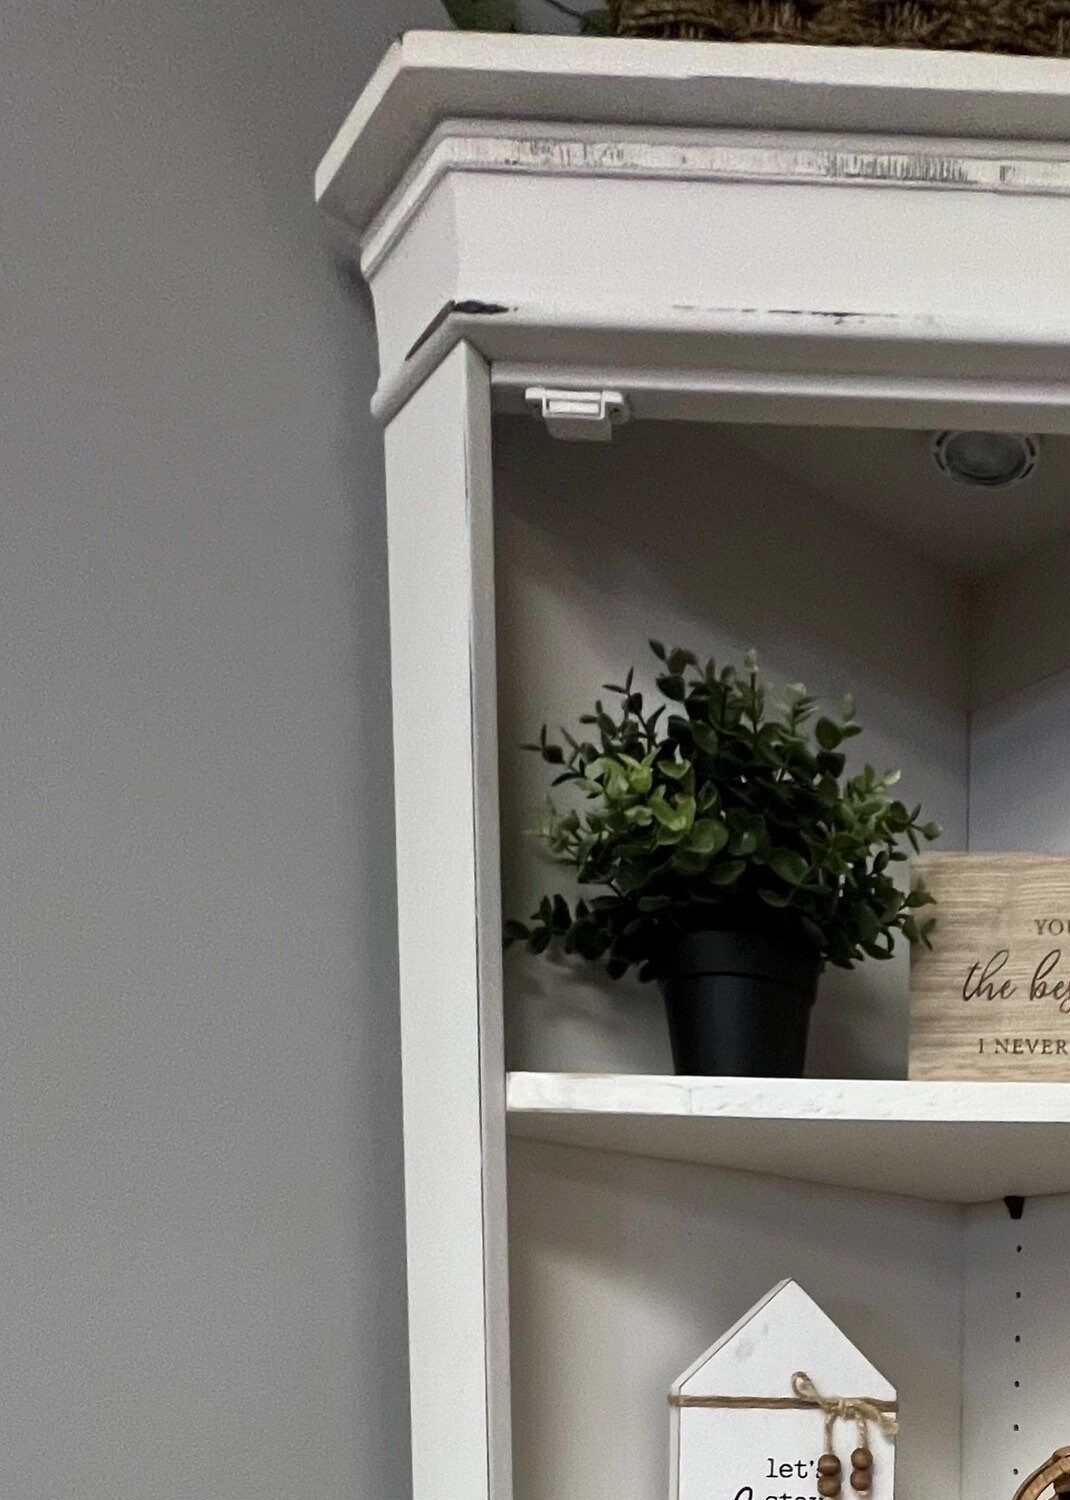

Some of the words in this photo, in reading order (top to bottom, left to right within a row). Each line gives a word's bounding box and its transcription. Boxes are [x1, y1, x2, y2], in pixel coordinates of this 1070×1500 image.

[962, 949, 1017, 1002] the
[978, 1039, 985, 1055] I
[994, 1039, 1068, 1056] NEVER
